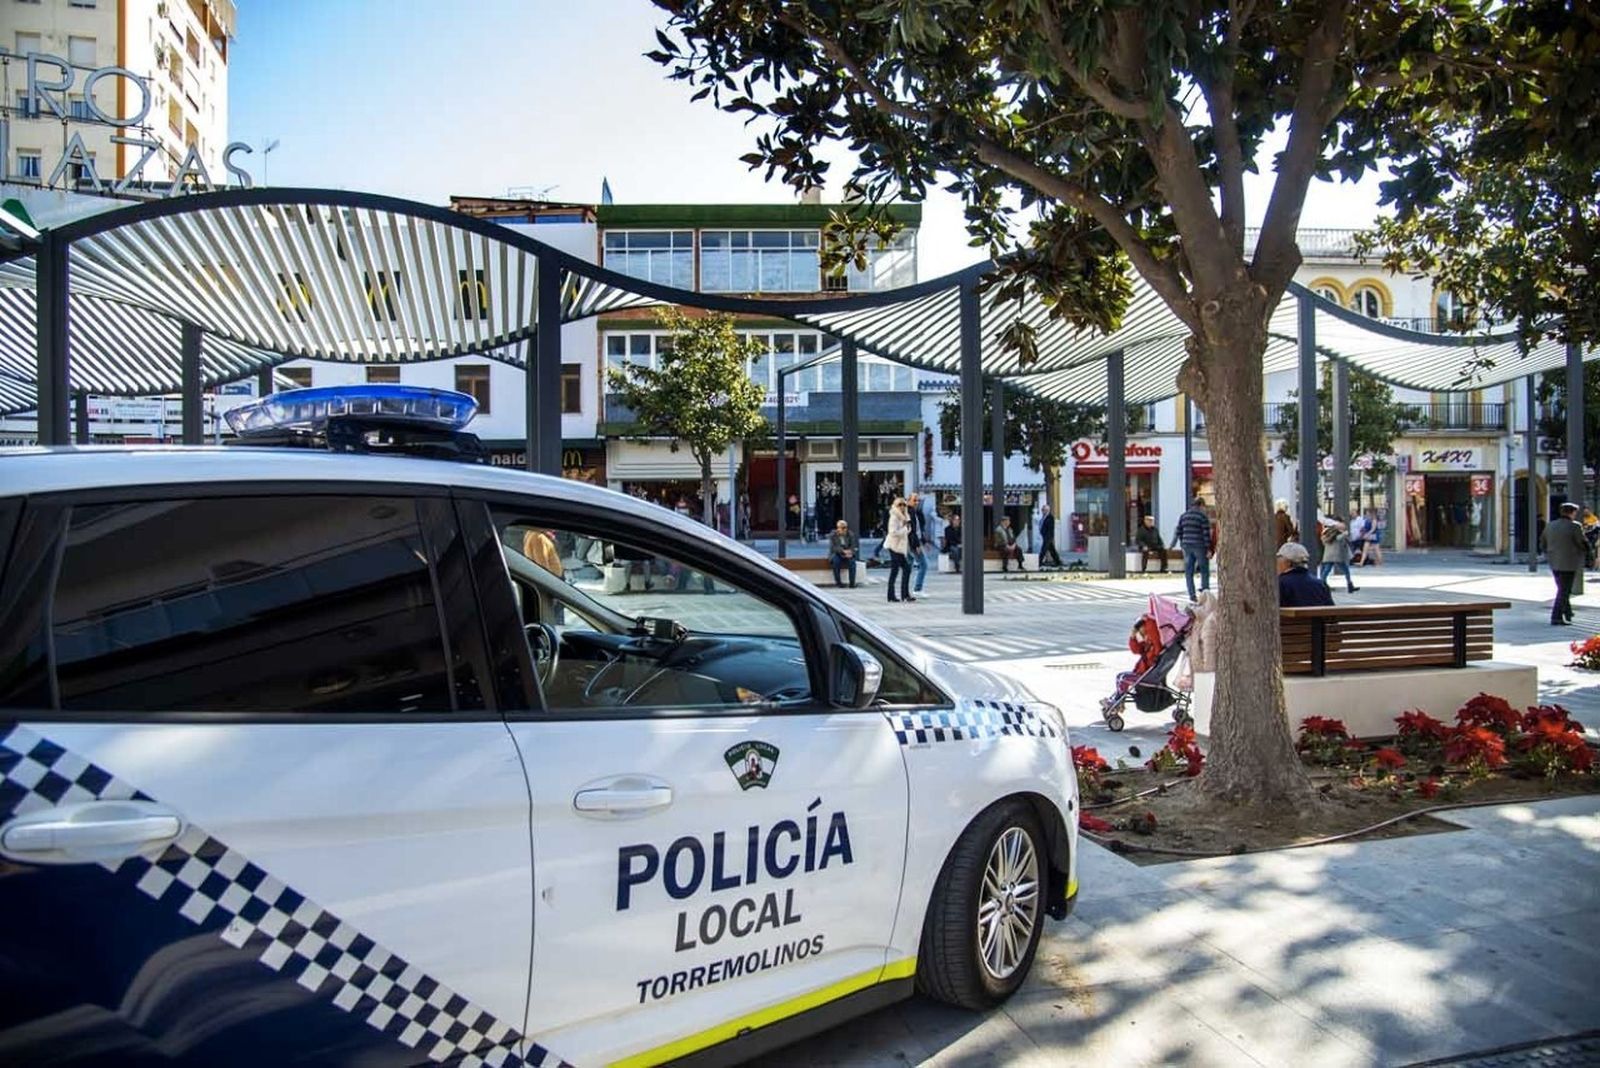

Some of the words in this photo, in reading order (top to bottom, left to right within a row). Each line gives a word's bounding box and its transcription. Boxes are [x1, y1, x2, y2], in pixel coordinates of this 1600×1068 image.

[1095, 443, 1162, 457] voafone
[616, 796, 853, 912] POLICÍA
[675, 888, 802, 953] LOCAL
[636, 934, 825, 1004] TORREMOLINOS
